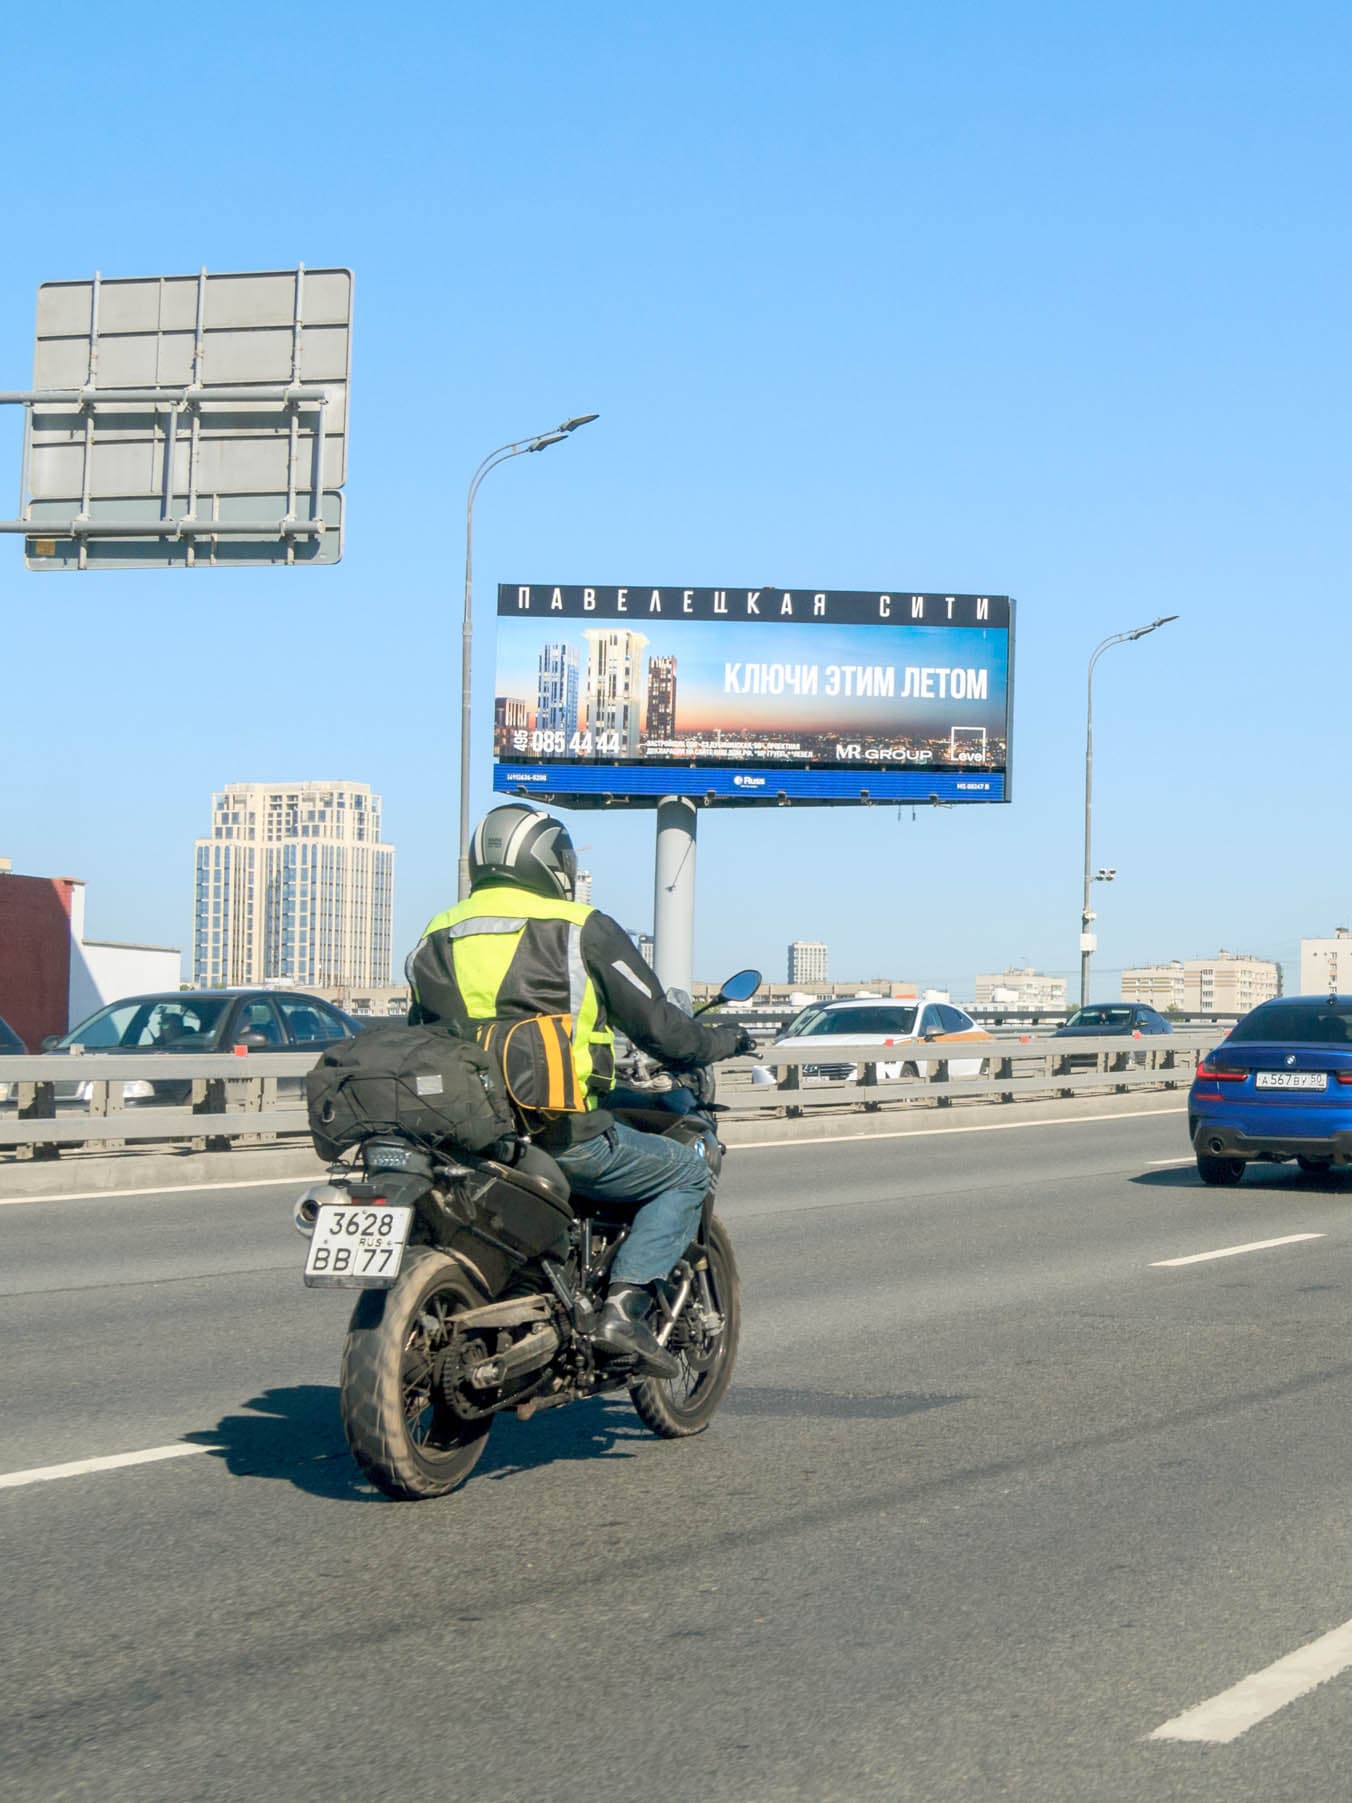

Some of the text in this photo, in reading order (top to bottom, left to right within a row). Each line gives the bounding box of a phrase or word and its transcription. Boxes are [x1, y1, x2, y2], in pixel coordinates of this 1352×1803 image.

[518, 586, 989, 620] ПАВЕЛЕЦКАЯ СИТИ
[724, 663, 988, 700] КЛЮЧИ ЭТИМ ЛЕТОМ
[513, 730, 528, 752] 495
[532, 730, 566, 753] 085
[569, 731, 593, 754] 44
[597, 731, 621, 754] 44
[836, 744, 932, 760] MR GROUP
[951, 747, 986, 762] Level
[329, 1212, 393, 1237] 3628
[359, 1238, 383, 1248] RUS
[362, 1249, 394, 1273] 77
